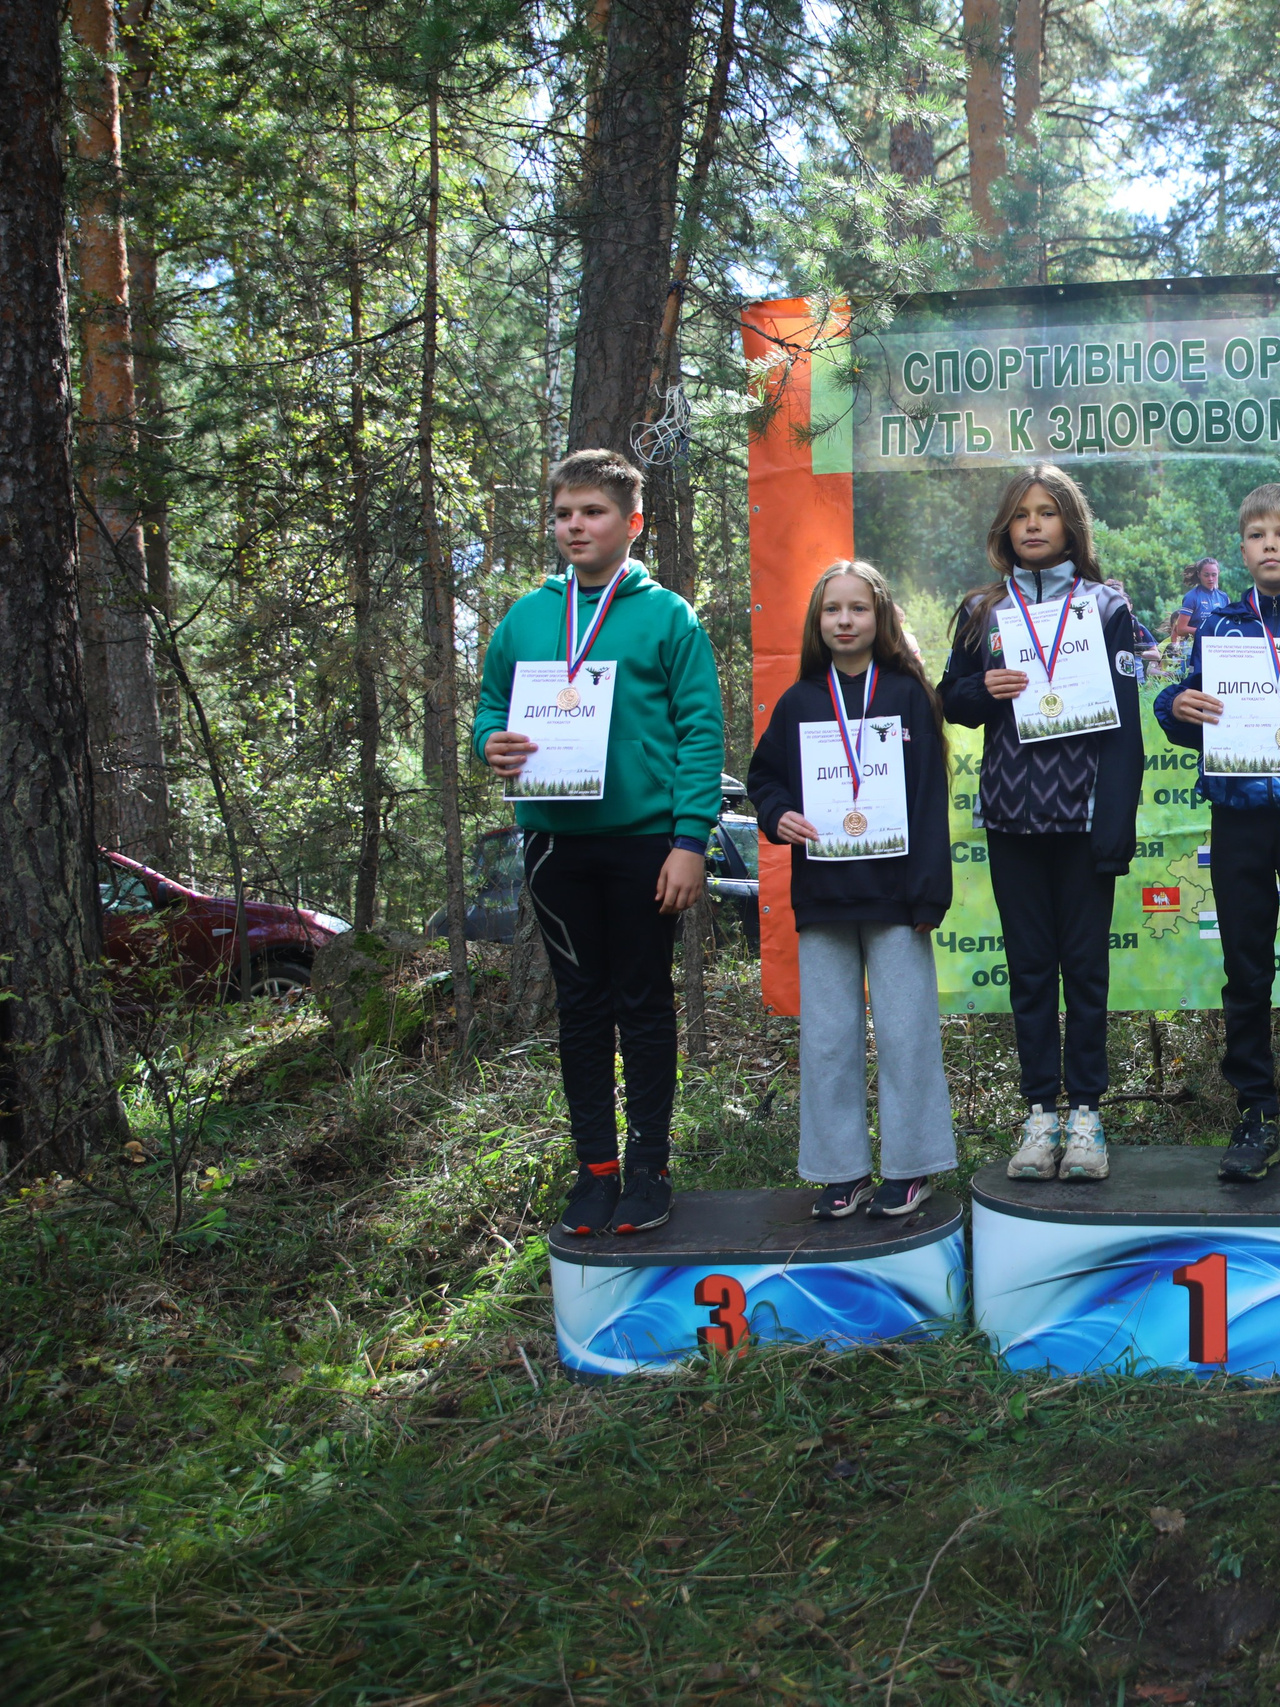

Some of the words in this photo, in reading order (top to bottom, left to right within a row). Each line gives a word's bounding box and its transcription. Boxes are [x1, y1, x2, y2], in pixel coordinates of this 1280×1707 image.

[903, 339, 1207, 396] СПОРТИВНОЕ
[880, 410, 993, 457] ПУТЬ
[1009, 407, 1035, 452] К
[1217, 681, 1278, 694] ДИПЛО
[817, 763, 888, 780] ДИПОМ
[694, 1273, 751, 1360] 3
[1173, 1252, 1229, 1364] 1
